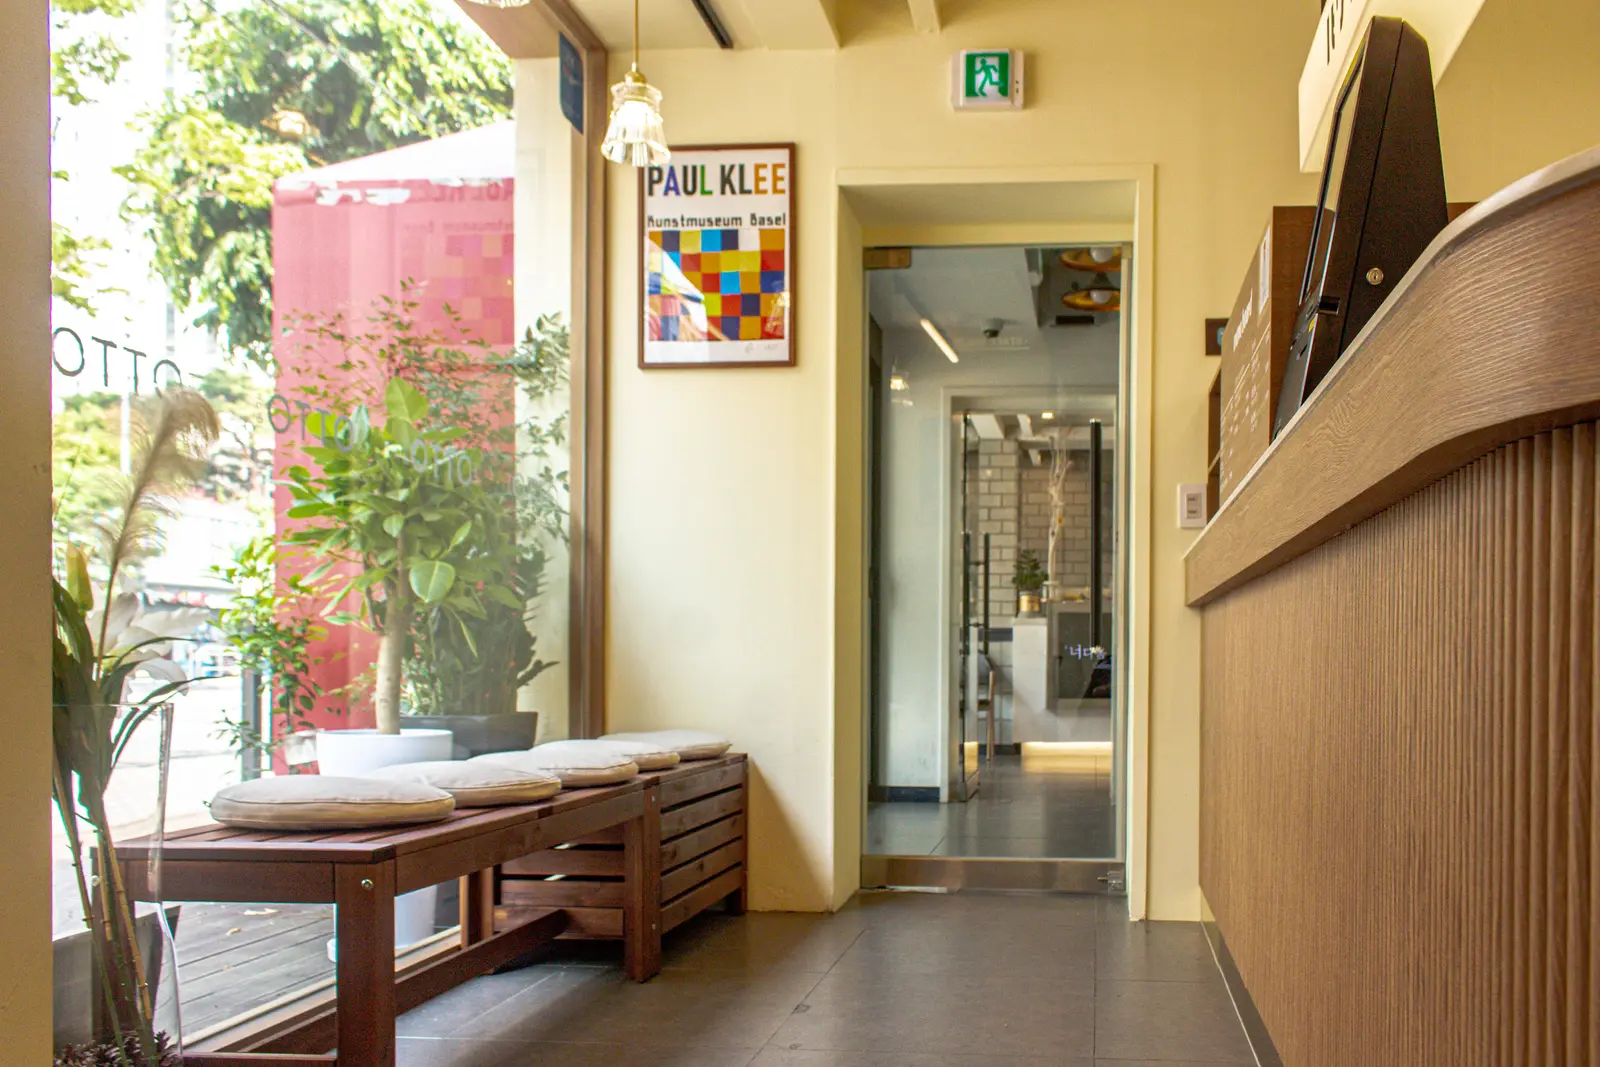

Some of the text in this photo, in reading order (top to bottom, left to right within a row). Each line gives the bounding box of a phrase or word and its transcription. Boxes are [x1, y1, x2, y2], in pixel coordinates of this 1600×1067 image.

[648, 163, 786, 196] PAUL KLEE
[647, 212, 787, 228] Kunstmuseum Basel
[52, 326, 183, 398] OTTO
[266, 394, 354, 453] OTTO
[411, 438, 472, 486] OTTO
